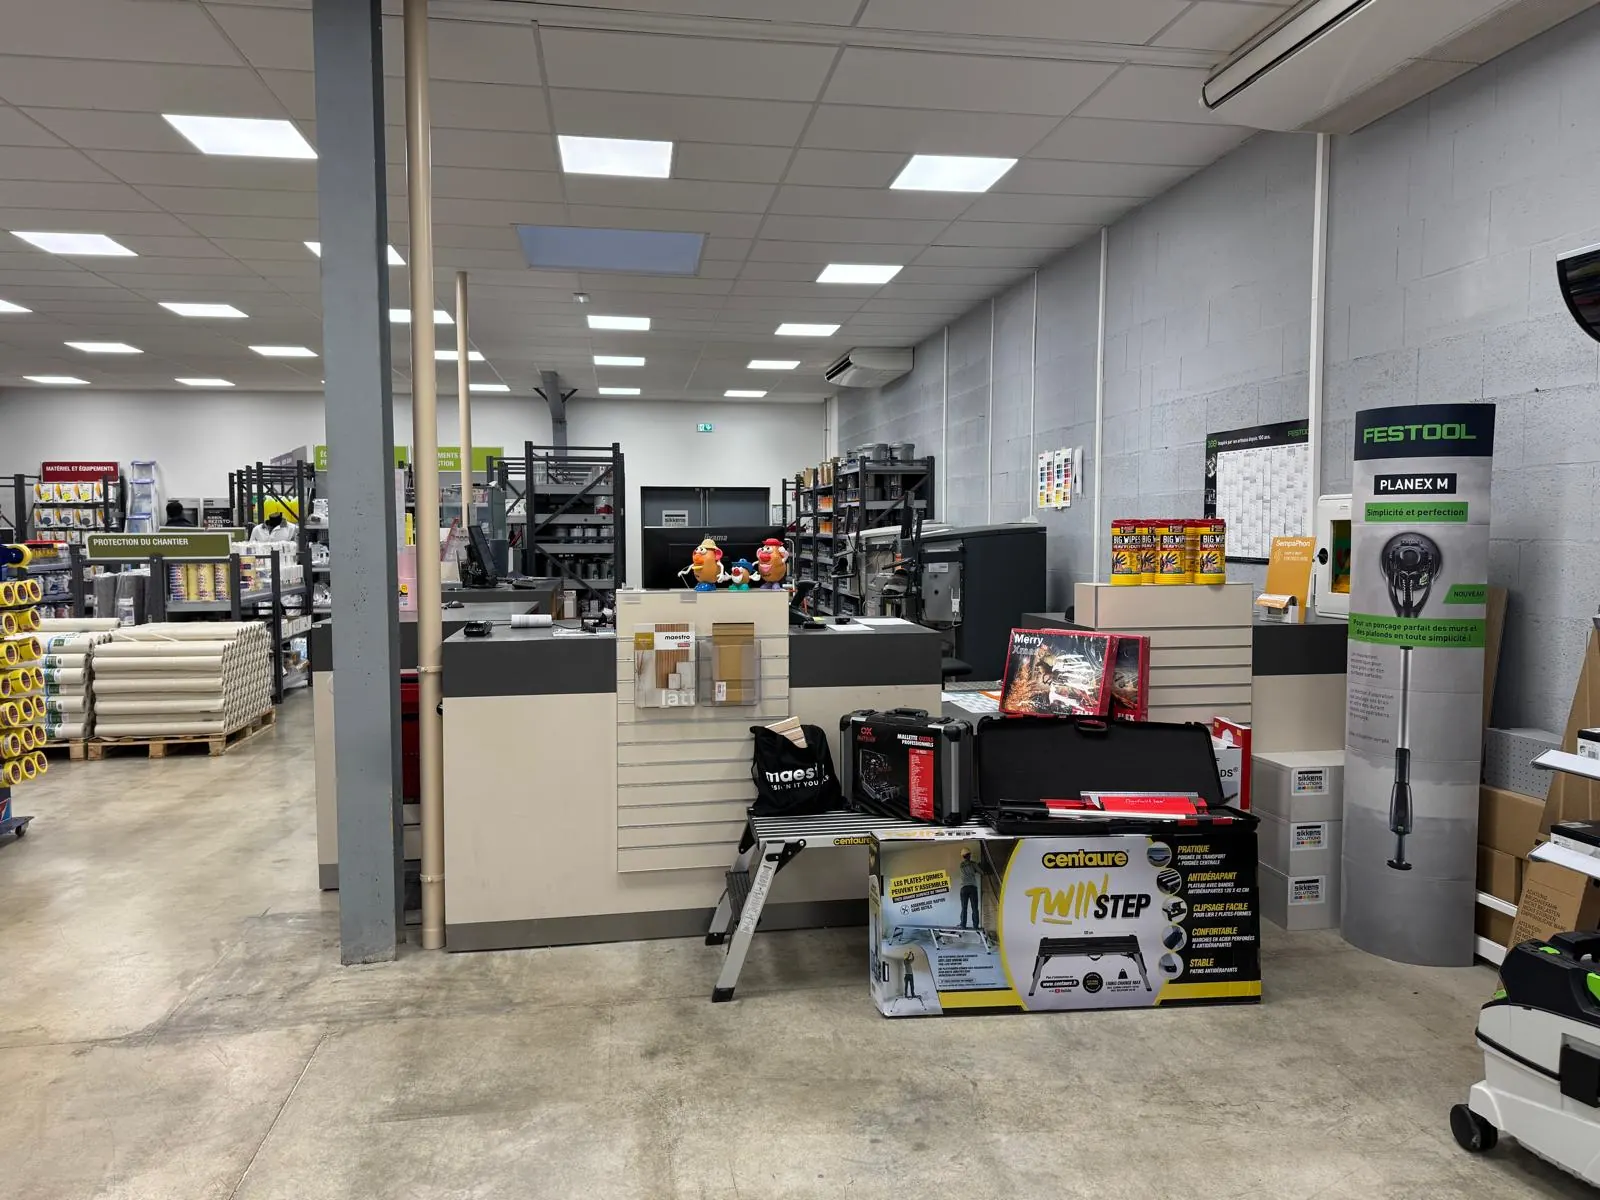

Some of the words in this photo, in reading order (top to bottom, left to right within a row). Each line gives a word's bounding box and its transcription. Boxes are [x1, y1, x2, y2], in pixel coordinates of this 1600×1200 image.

[1363, 423, 1477, 443] FESTOOL
[1380, 478, 1432, 491] PLANEX
[1437, 478, 1448, 490] M
[1367, 507, 1404, 517] Simplicité
[1406, 508, 1415, 516] et
[1417, 508, 1464, 517] perfection
[93, 538, 139, 546] PROTECTION
[140, 538, 150, 546] DU
[152, 538, 189, 546] CHANTIER
[1114, 535, 1123, 544] BIG
[1162, 535, 1174, 544] BIG
[1202, 535, 1214, 544] BIG
[1453, 590, 1484, 598] NOUVEAU
[1373, 622, 1402, 630] ponçage
[1404, 624, 1430, 632] parfait
[1014, 633, 1044, 647] Merry
[1428, 634, 1466, 643] simplicité
[897, 733, 918, 741] MALLETTE
[766, 762, 824, 782] maes
[1298, 774, 1322, 782] sikkens
[1296, 829, 1322, 837] sikkens
[1177, 844, 1210, 854] PRATIQUE
[1043, 850, 1127, 868] centaure
[904, 872, 944, 886] PLATES-FORMES
[1188, 870, 1238, 882] ANTIDÉRAPANT
[892, 886, 914, 896] PEUVENT
[914, 880, 948, 892] S'ASSEMBLER
[1294, 884, 1319, 892] sikkens
[1025, 872, 1109, 925] TWIN
[1094, 893, 1152, 920] STEP
[1193, 904, 1224, 912] CLIPSAGE
[1226, 902, 1248, 910] FACILE
[1192, 926, 1238, 936] CONFORTABLE
[1190, 958, 1214, 968] STABLE
